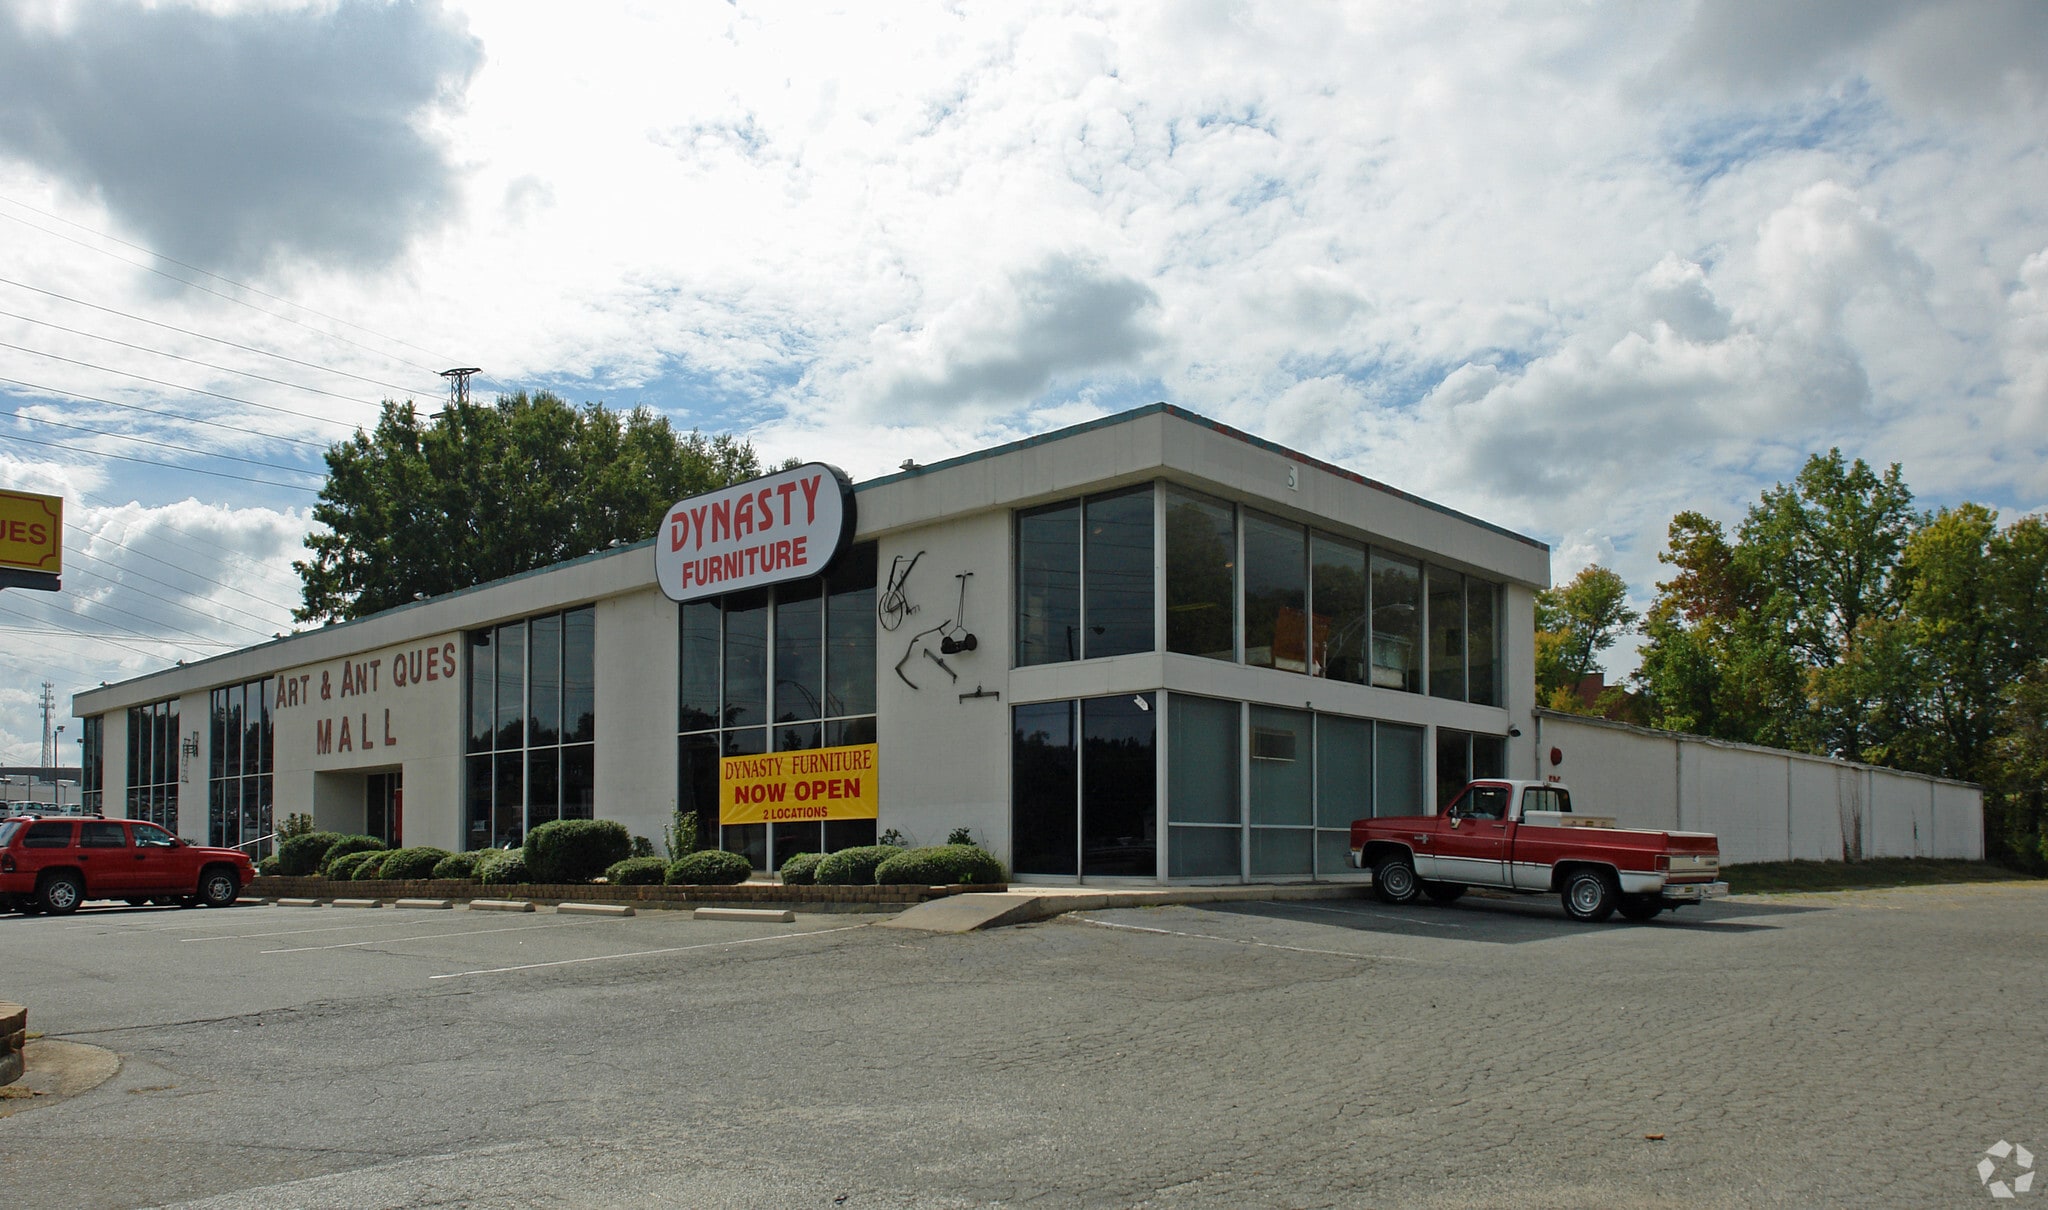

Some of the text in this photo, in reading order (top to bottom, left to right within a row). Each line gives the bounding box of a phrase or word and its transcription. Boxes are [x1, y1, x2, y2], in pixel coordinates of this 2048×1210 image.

[671, 474, 822, 553] DYNASTY
[682, 535, 807, 589] FURNITURE
[275, 674, 310, 709] ART
[320, 669, 332, 701] &
[316, 708, 397, 755] MALL
[725, 749, 872, 780] DYNASTY FURNITURE
[734, 777, 861, 805] NOW OPEN
[763, 806, 828, 820] 2 LOCATIONS
